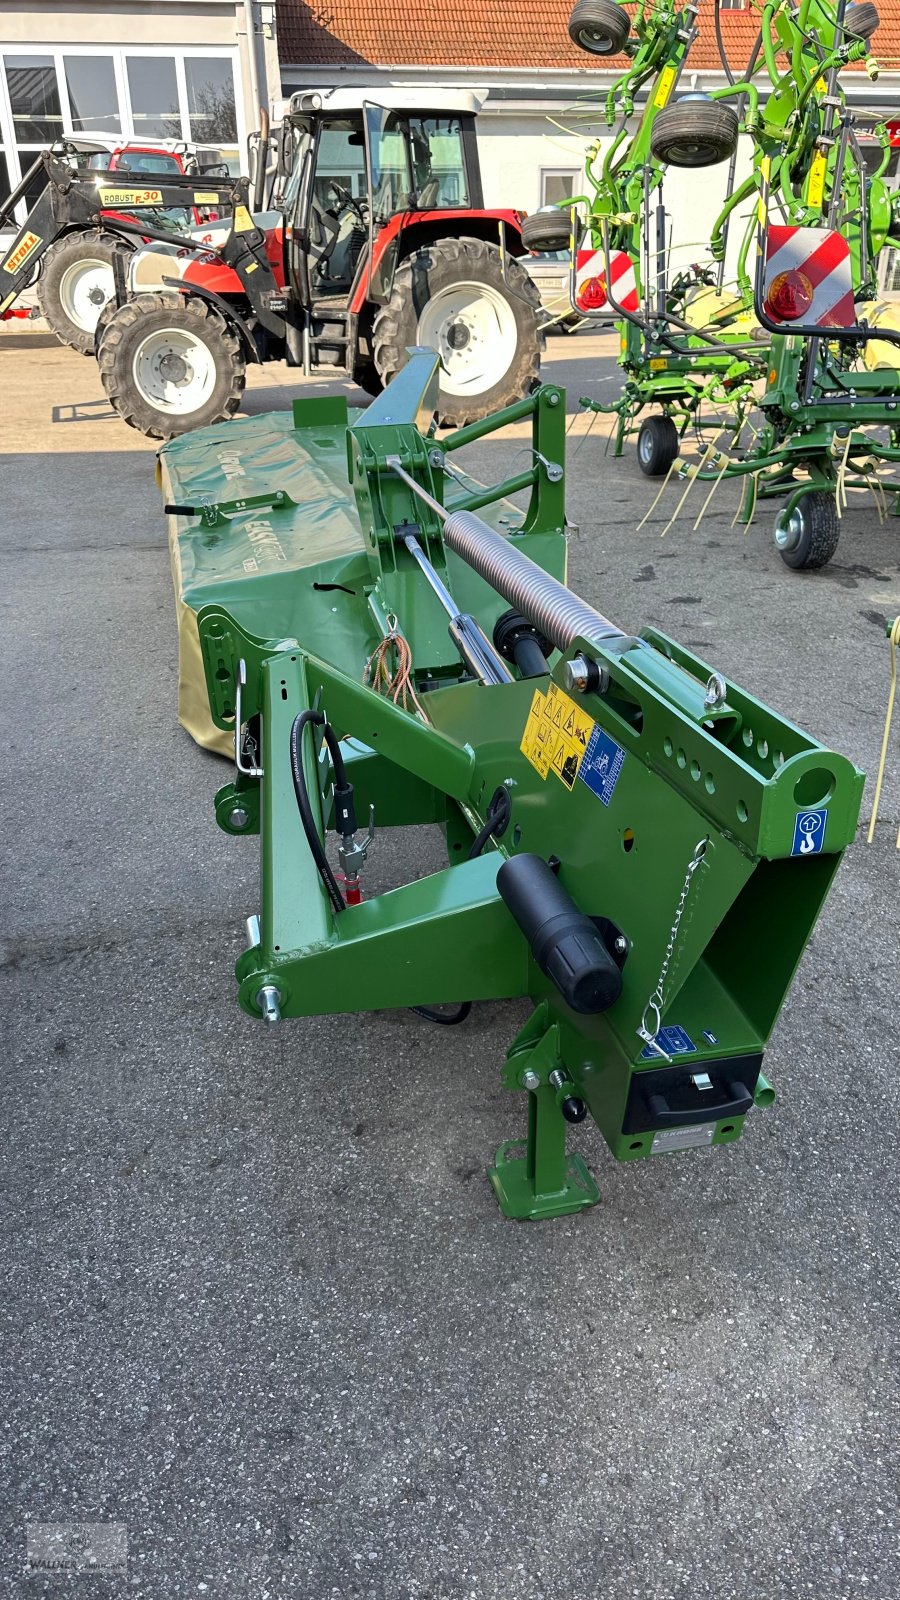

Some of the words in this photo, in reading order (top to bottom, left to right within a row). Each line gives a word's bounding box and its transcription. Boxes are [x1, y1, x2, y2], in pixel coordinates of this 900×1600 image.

[104, 194, 134, 202] ROBUST
[7, 235, 38, 271] STOLL
[293, 752, 301, 782] HYDRAULIK
